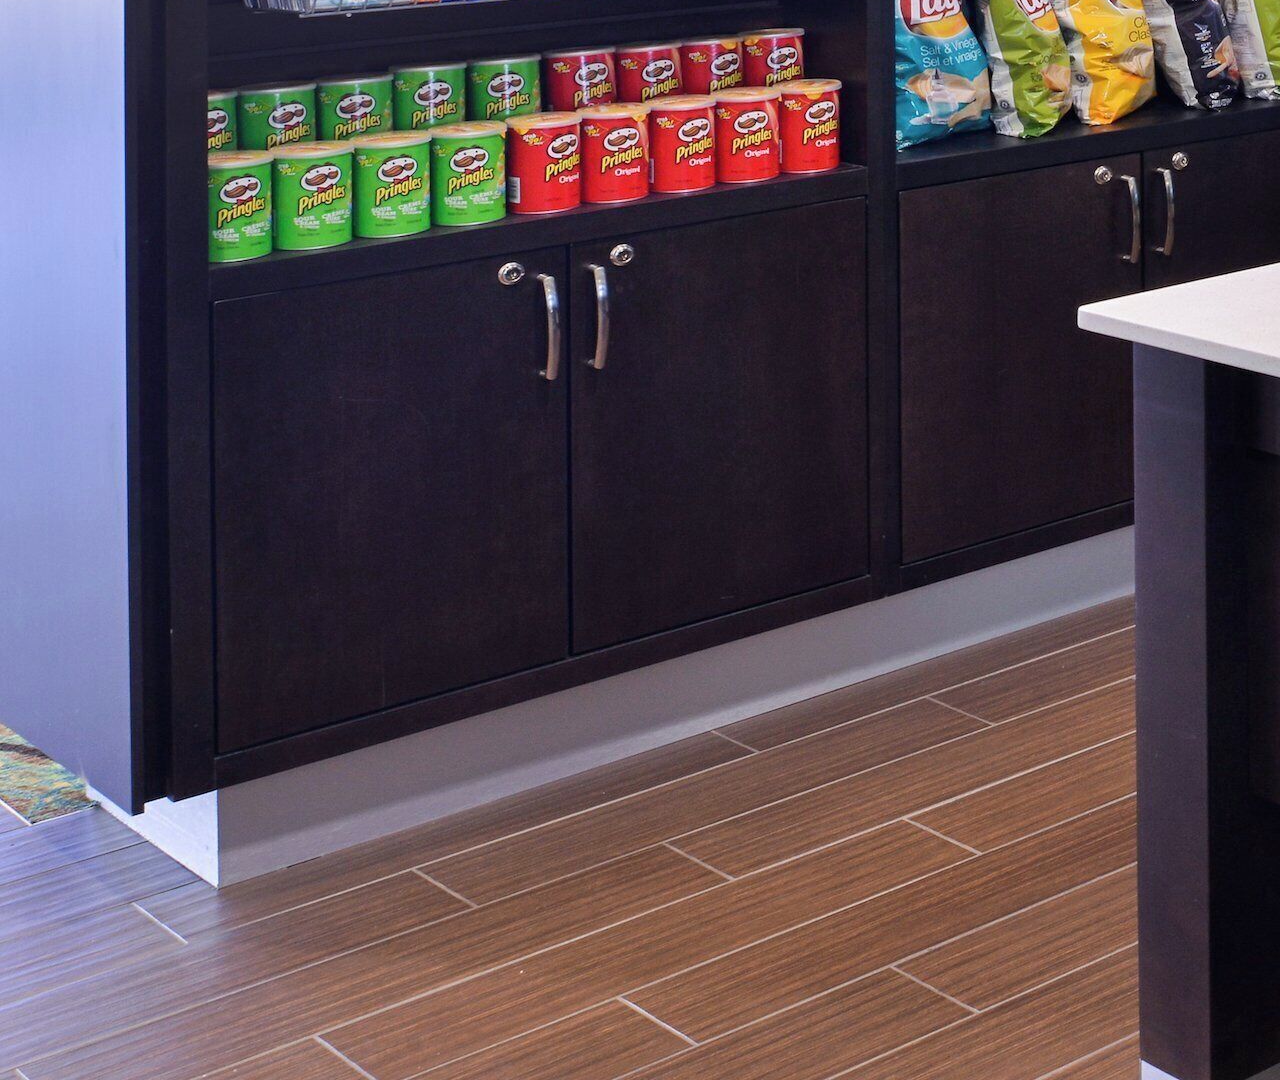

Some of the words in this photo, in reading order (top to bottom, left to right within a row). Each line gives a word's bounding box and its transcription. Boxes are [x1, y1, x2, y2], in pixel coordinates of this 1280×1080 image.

[920, 45, 942, 57] Salt
[944, 44, 952, 53] &
[923, 57, 940, 67] Sel
[942, 55, 954, 66] et
[709, 69, 743, 93] Pringles
[766, 63, 801, 87] Pringles
[574, 81, 613, 106] Pringles
[641, 77, 679, 102] Pringles
[412, 100, 457, 128] Pringles
[486, 91, 530, 118] Pringles
[266, 123, 311, 149] Pringles
[334, 113, 382, 140] Pringles
[803, 119, 839, 144] Pringles
[676, 136, 713, 163] Pringles
[732, 128, 772, 153] Pringles
[545, 152, 580, 182] Pringles
[601, 147, 644, 172] Pringles
[374, 175, 422, 206] Pringles
[447, 165, 494, 194] Pringles
[216, 197, 266, 229] Pringles
[297, 184, 345, 216] Pringles
